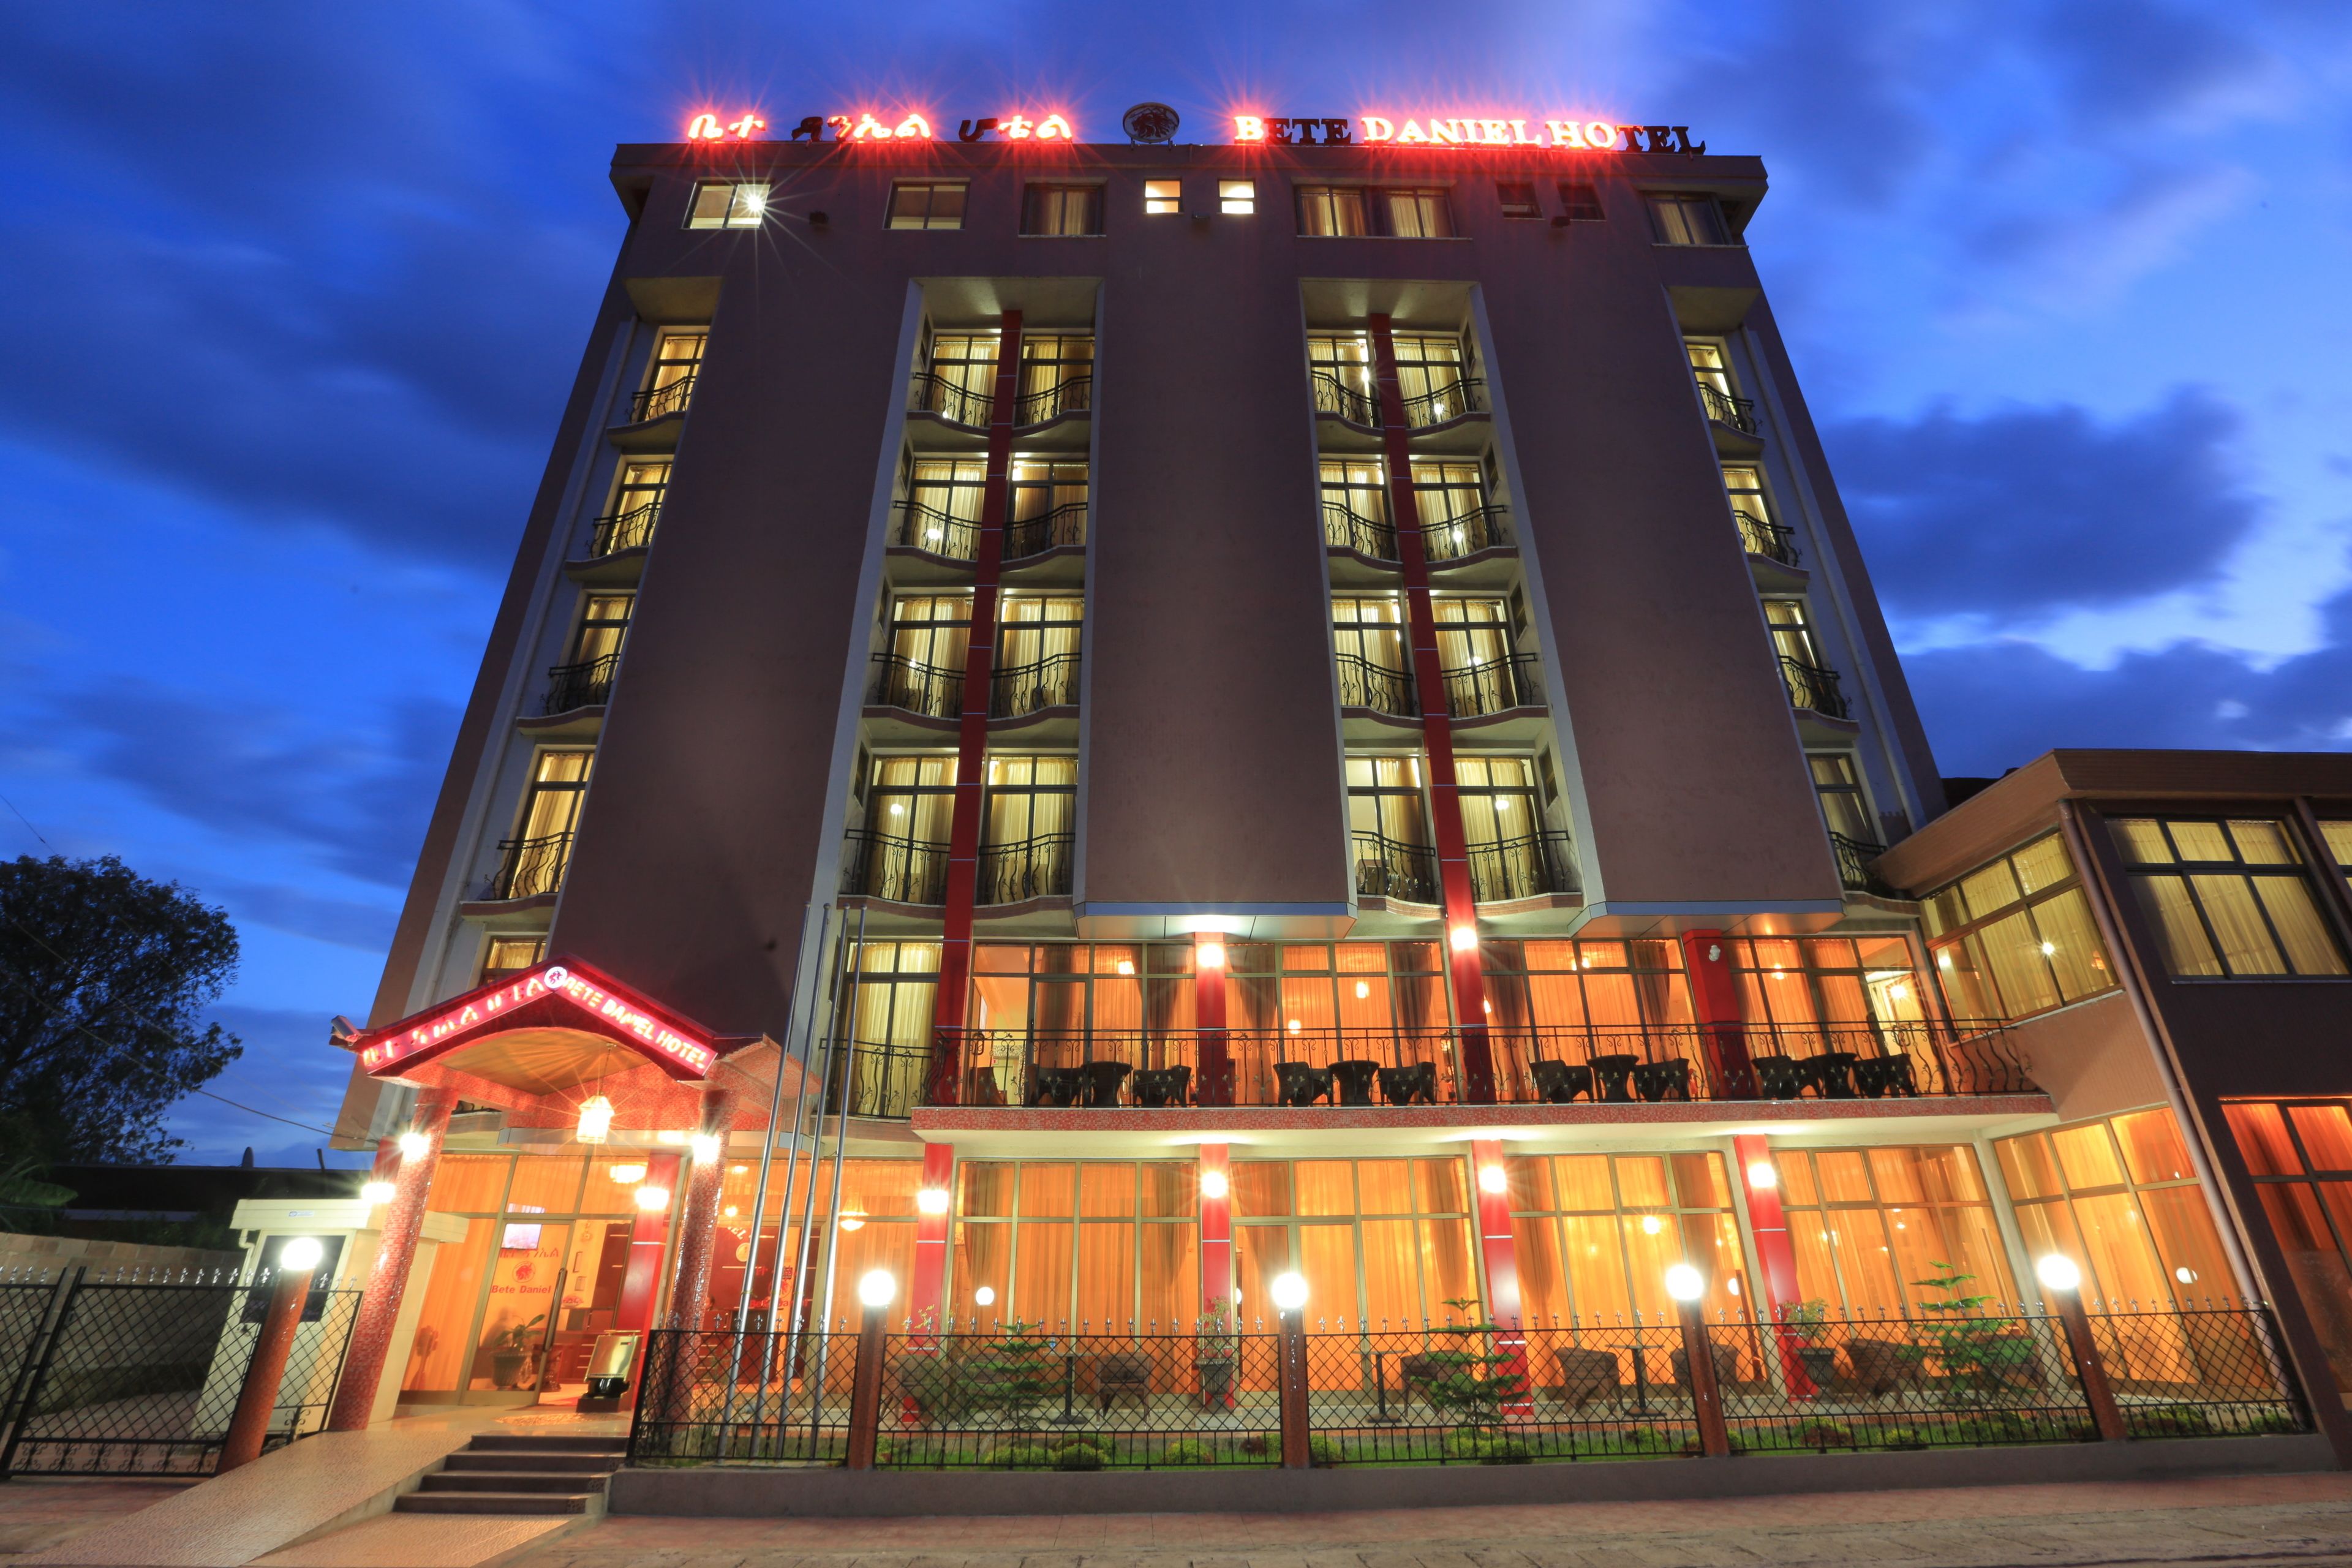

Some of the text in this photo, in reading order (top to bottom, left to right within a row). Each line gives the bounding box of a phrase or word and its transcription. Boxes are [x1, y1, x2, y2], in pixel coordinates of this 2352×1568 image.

[688, 113, 1072, 142] ቤተ ዳንኤል ሆቴል
[1234, 116, 1706, 155] BETE DANIEL HOTEL
[601, 998, 654, 1040] DANIEL
[654, 1030, 707, 1069] HOTEL
